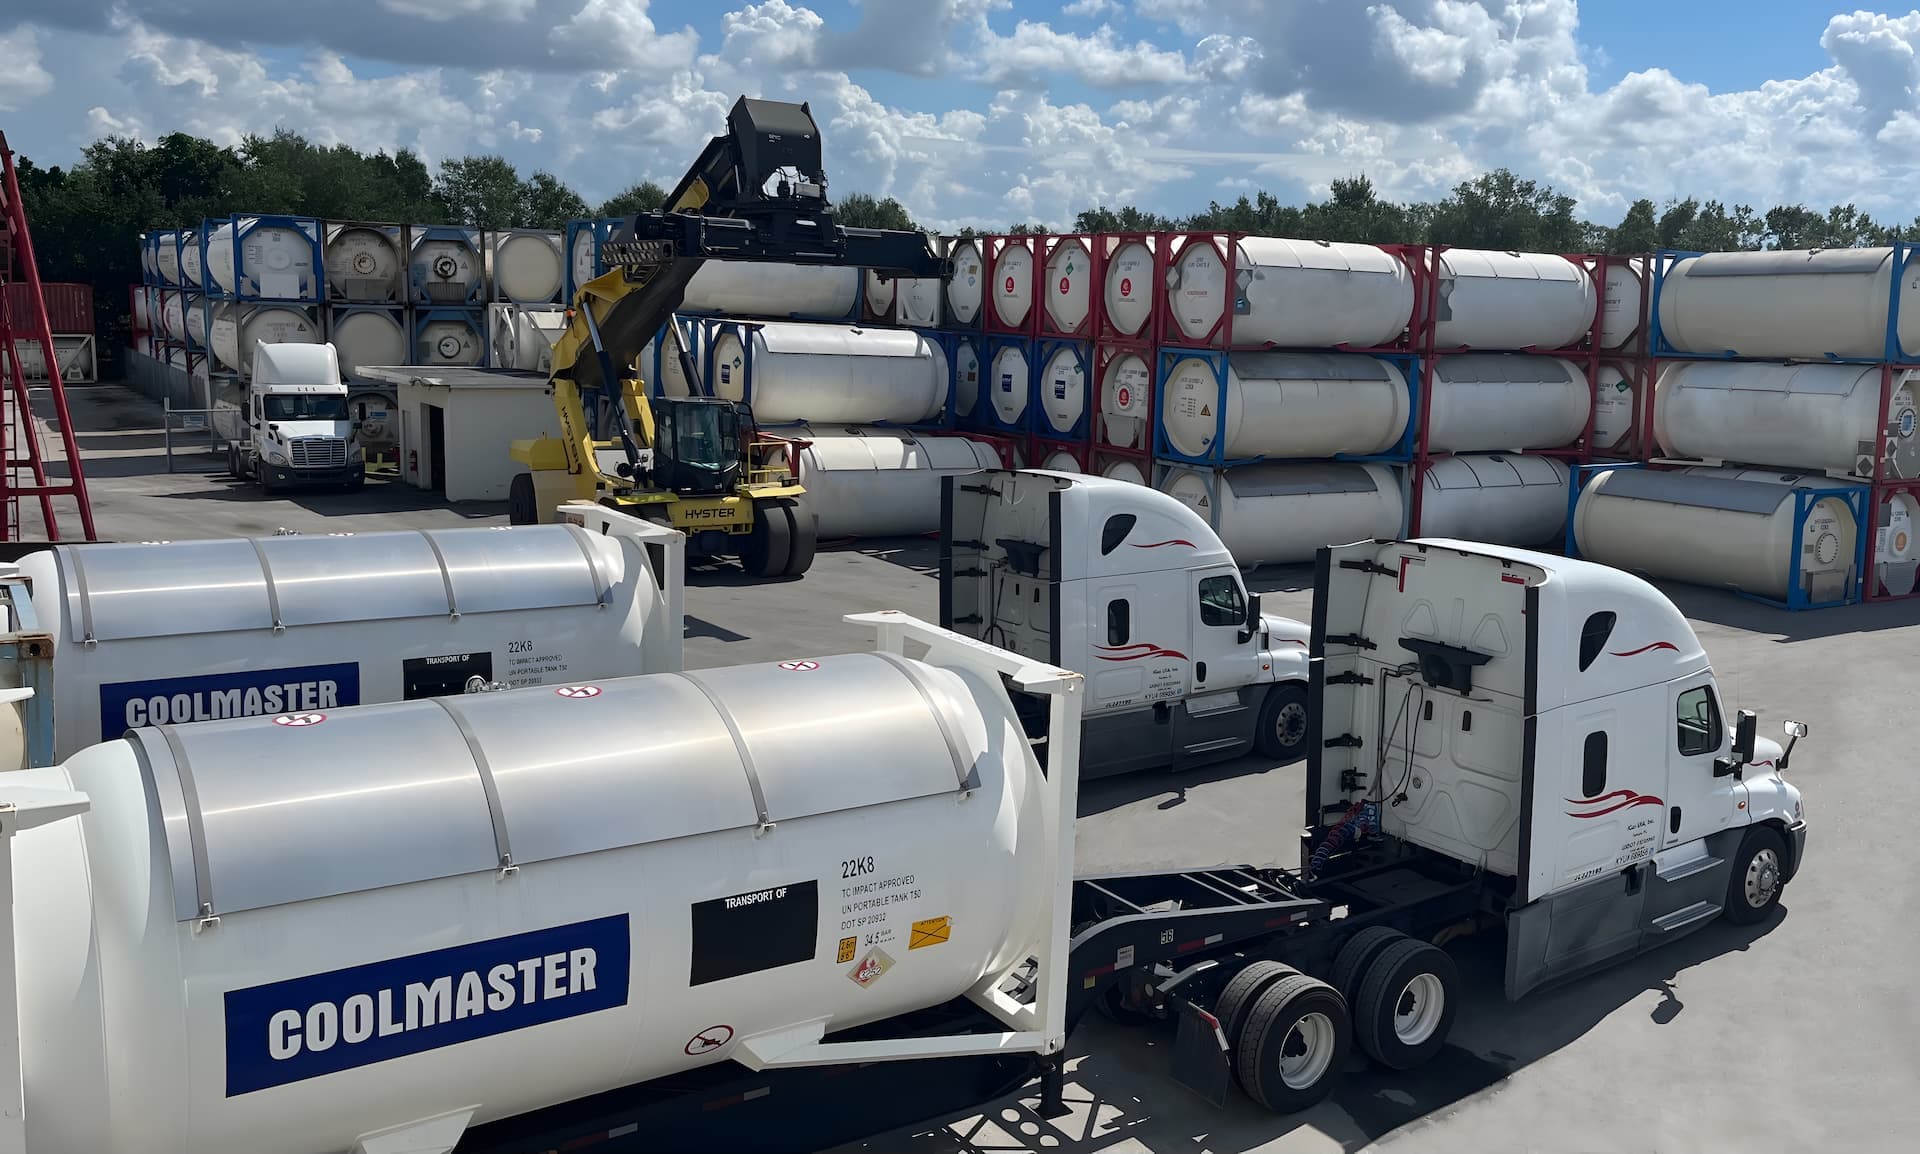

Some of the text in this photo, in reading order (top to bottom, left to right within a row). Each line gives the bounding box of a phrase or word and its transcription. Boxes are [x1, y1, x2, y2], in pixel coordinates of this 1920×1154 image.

[685, 508, 736, 520] HYSTER
[508, 640, 533, 653] 22K8
[426, 654, 470, 665] TRANSPORT OF
[535, 654, 563, 664] APPROVED
[517, 666, 544, 675] PORTABLE
[545, 665, 559, 673] TANK
[125, 680, 338, 728] COOLMASTER
[841, 856, 875, 879] 22K8
[841, 875, 915, 898] TC IMPACT APPROVED
[725, 887, 788, 910] TRANSPORT OF
[841, 889, 921, 914] UN PORTABLE TANK T50
[841, 912, 886, 930] DOT SP 20932
[864, 931, 880, 946] 34.5
[269, 947, 597, 1061] COOLMASTER
